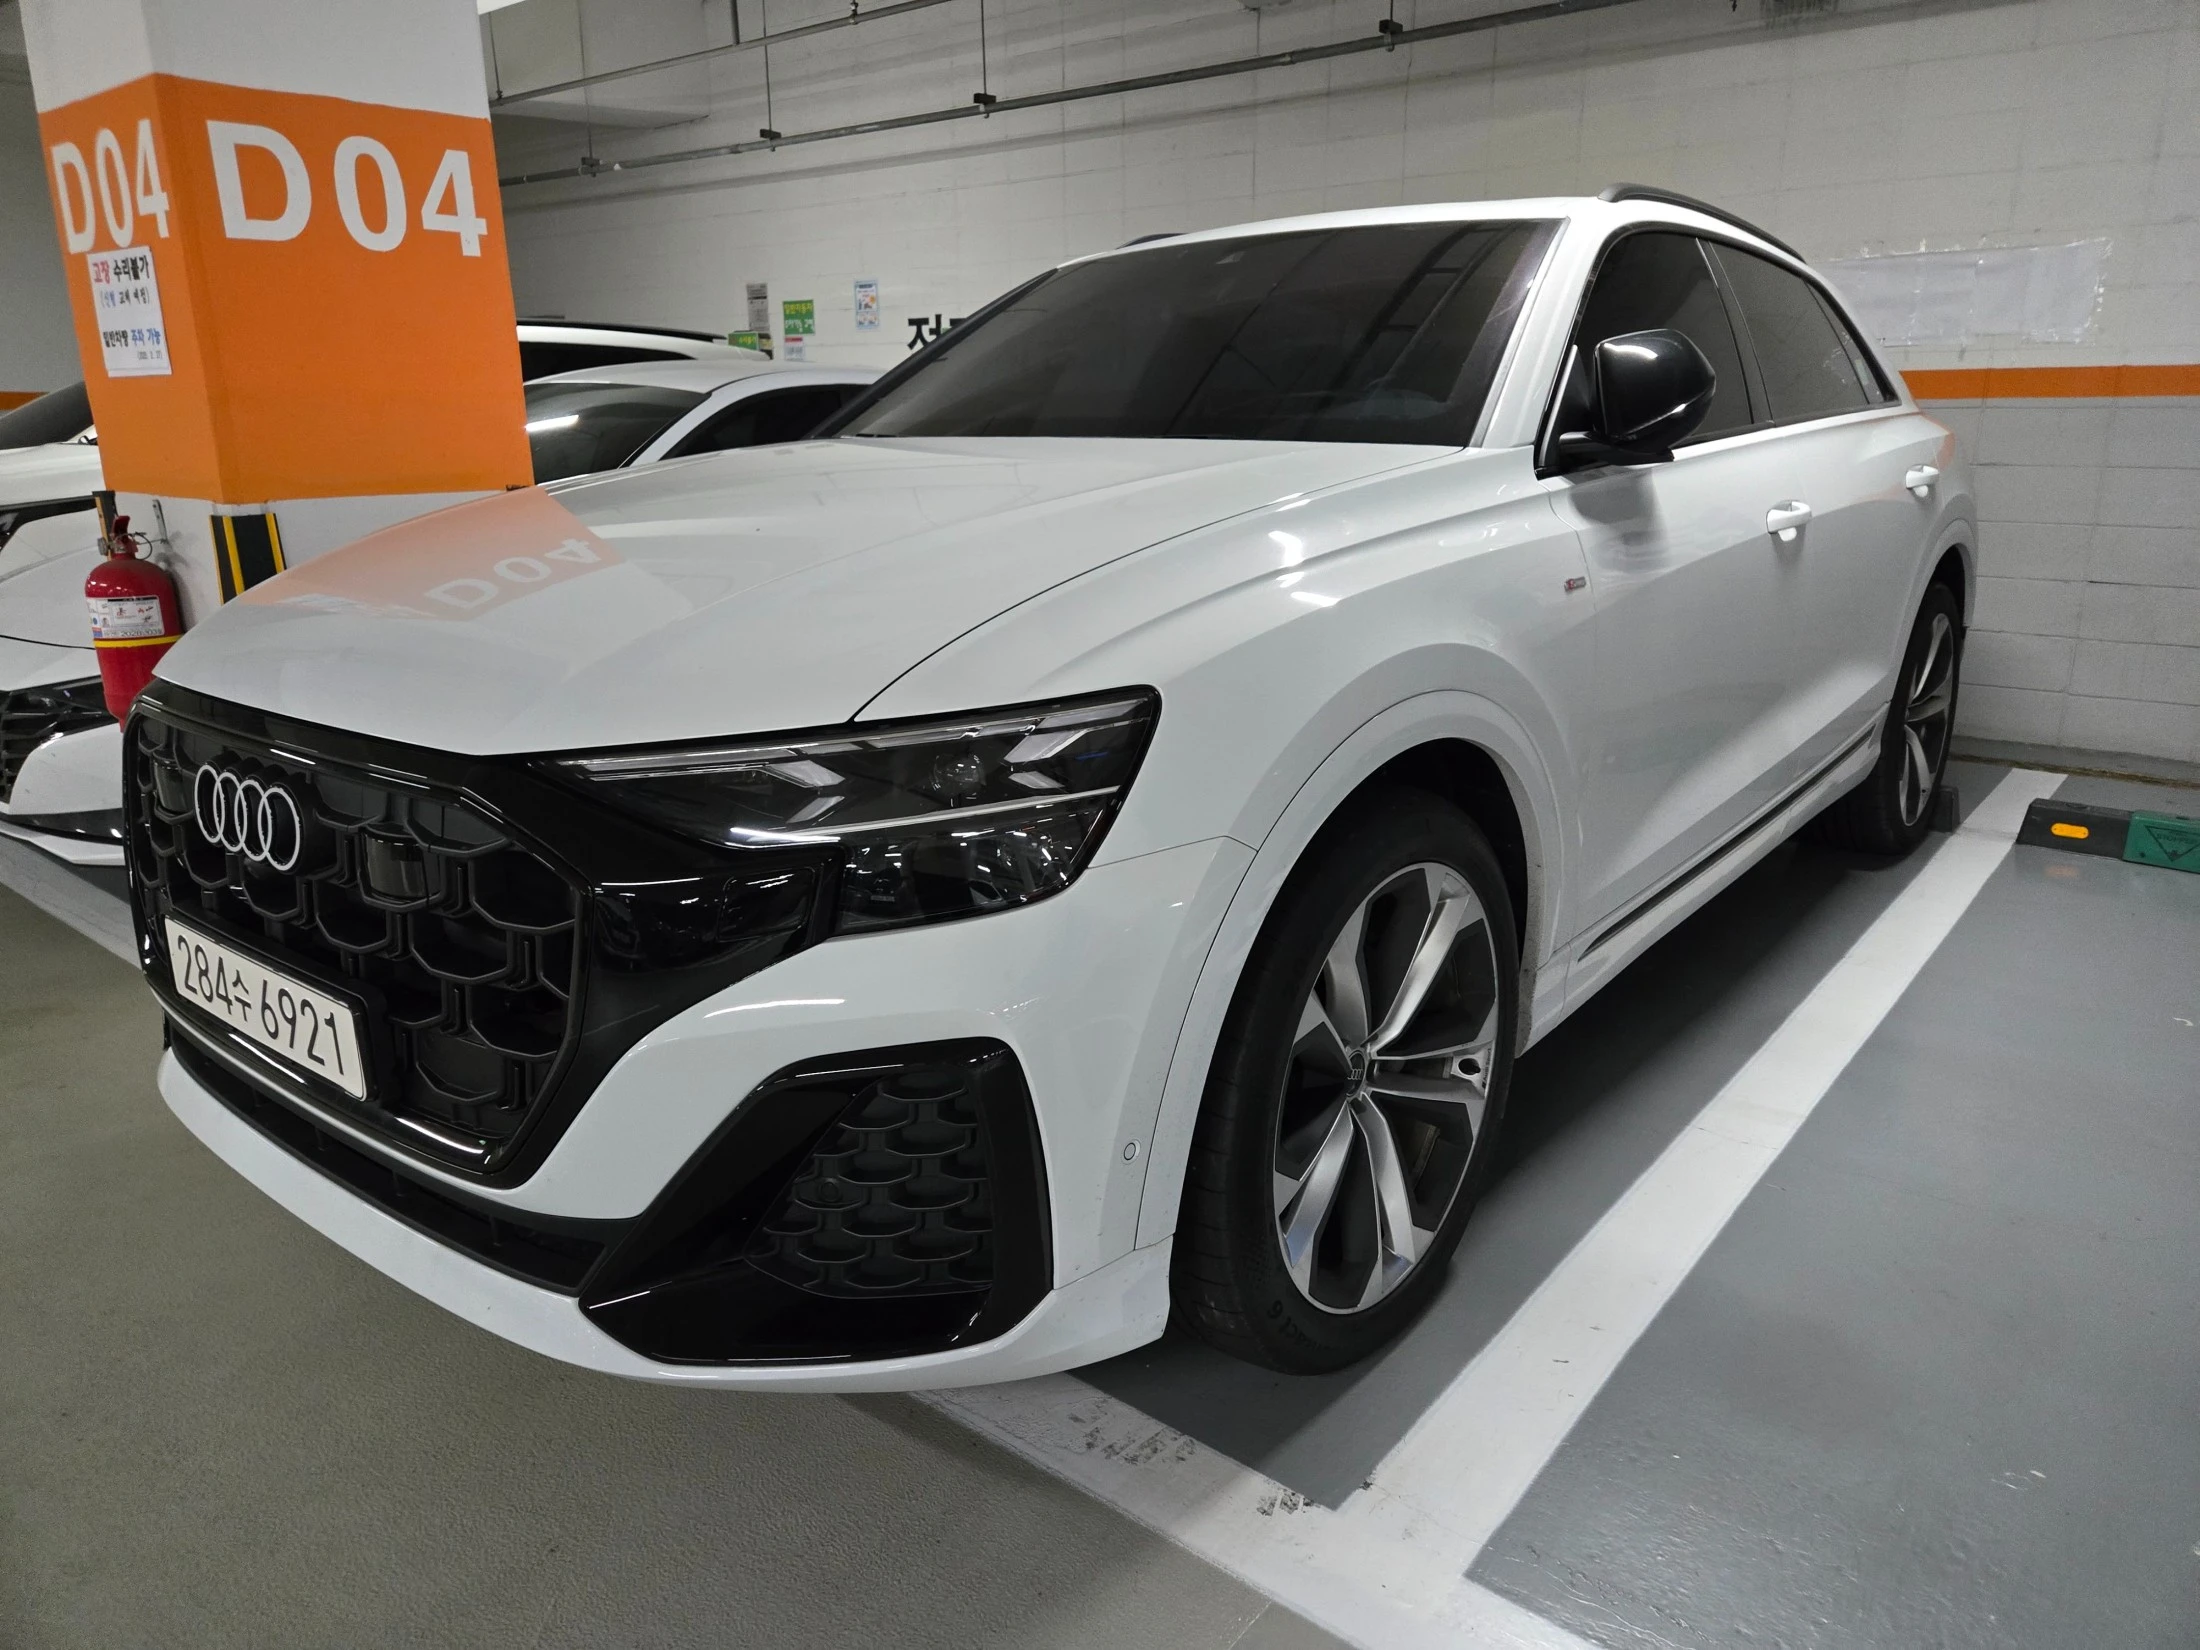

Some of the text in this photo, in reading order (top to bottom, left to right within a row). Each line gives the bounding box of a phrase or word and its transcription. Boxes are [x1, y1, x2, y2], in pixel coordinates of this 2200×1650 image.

[51, 119, 170, 254] D04
[208, 121, 487, 256] D04
[92, 255, 150, 284] 고장 수리불가
[103, 328, 161, 348] 일반차량 주차 가능
